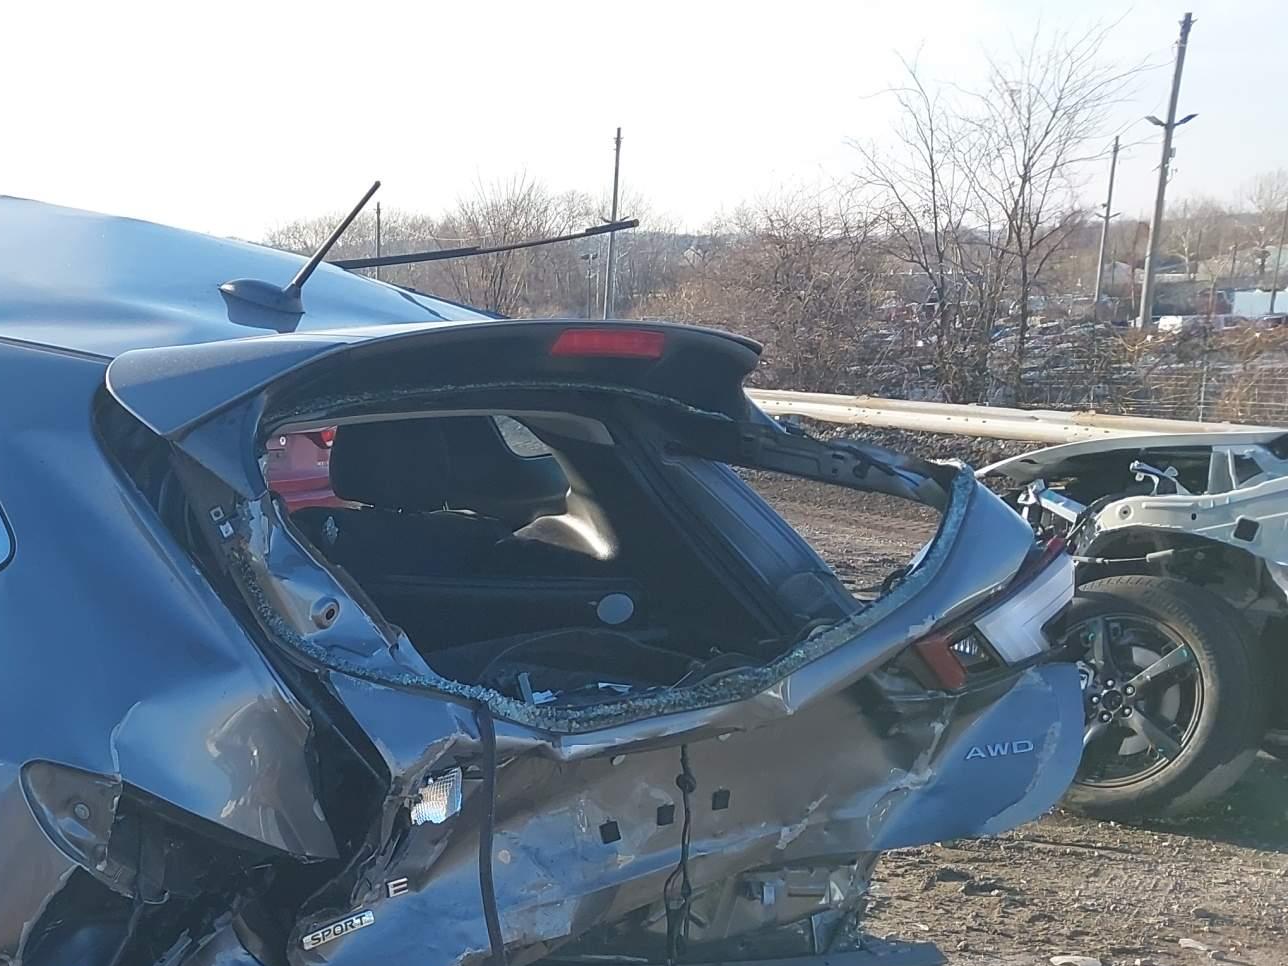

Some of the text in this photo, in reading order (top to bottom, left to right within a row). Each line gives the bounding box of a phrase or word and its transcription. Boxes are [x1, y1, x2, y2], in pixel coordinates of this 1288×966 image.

[965, 740, 1034, 760] AWD
[387, 877, 409, 898] E
[309, 913, 367, 946] SPORT
